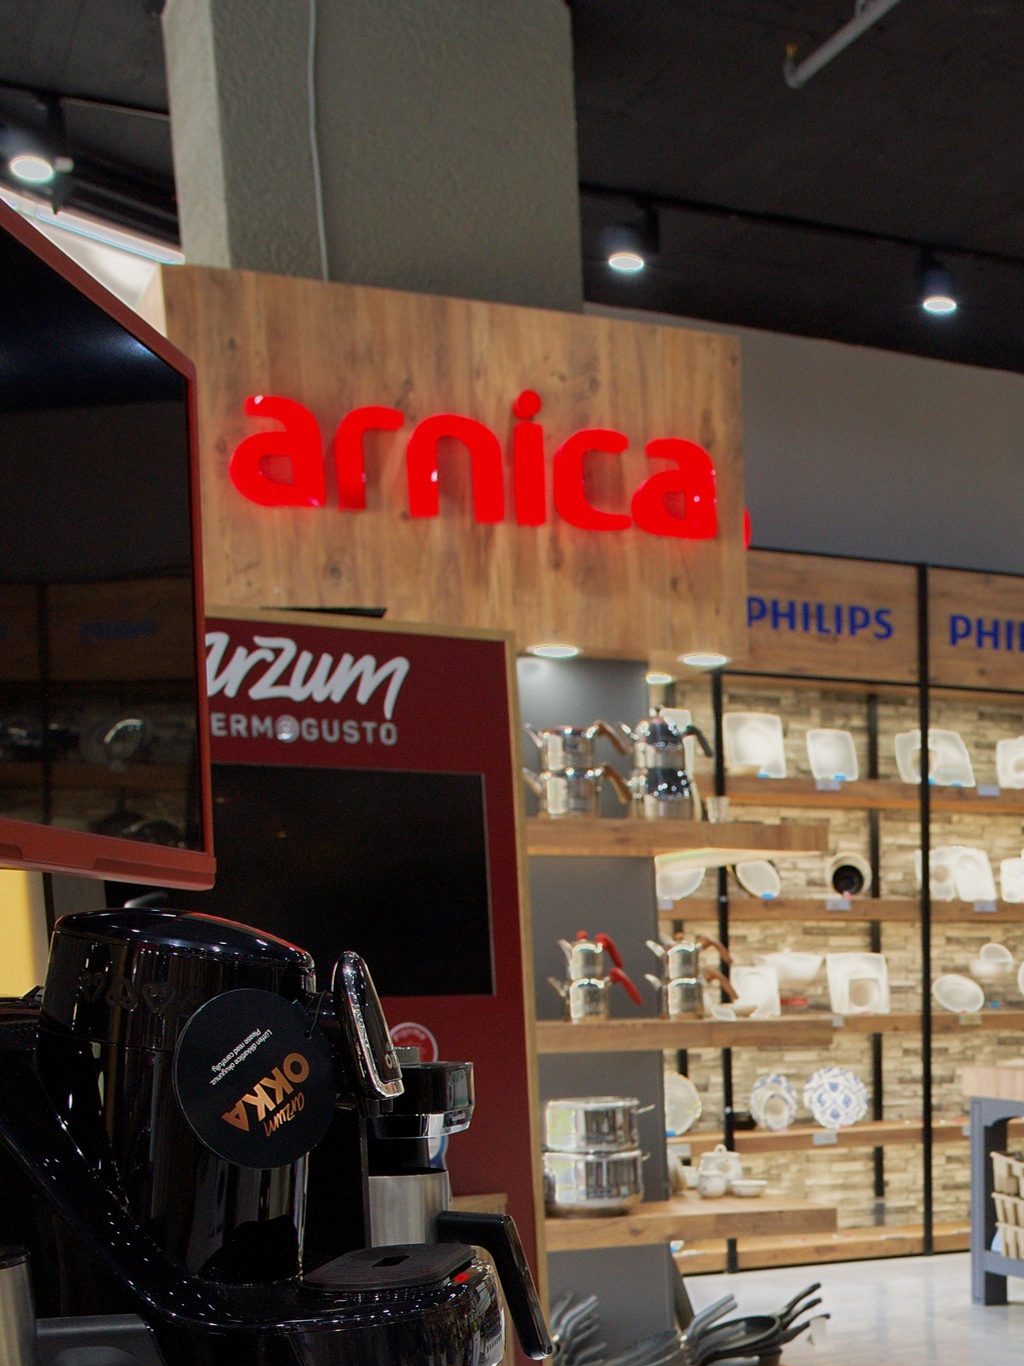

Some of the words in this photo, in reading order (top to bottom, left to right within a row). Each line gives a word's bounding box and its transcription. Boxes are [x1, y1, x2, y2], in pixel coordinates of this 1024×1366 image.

[228, 389, 719, 541] arnica
[746, 597, 893, 640] PHILIPS
[210, 711, 399, 746] ERMOGUSTO
[232, 1041, 246, 1056] read
[243, 1027, 262, 1045] Please
[221, 1052, 310, 1132] OKKA
[263, 1092, 305, 1137] arzum
